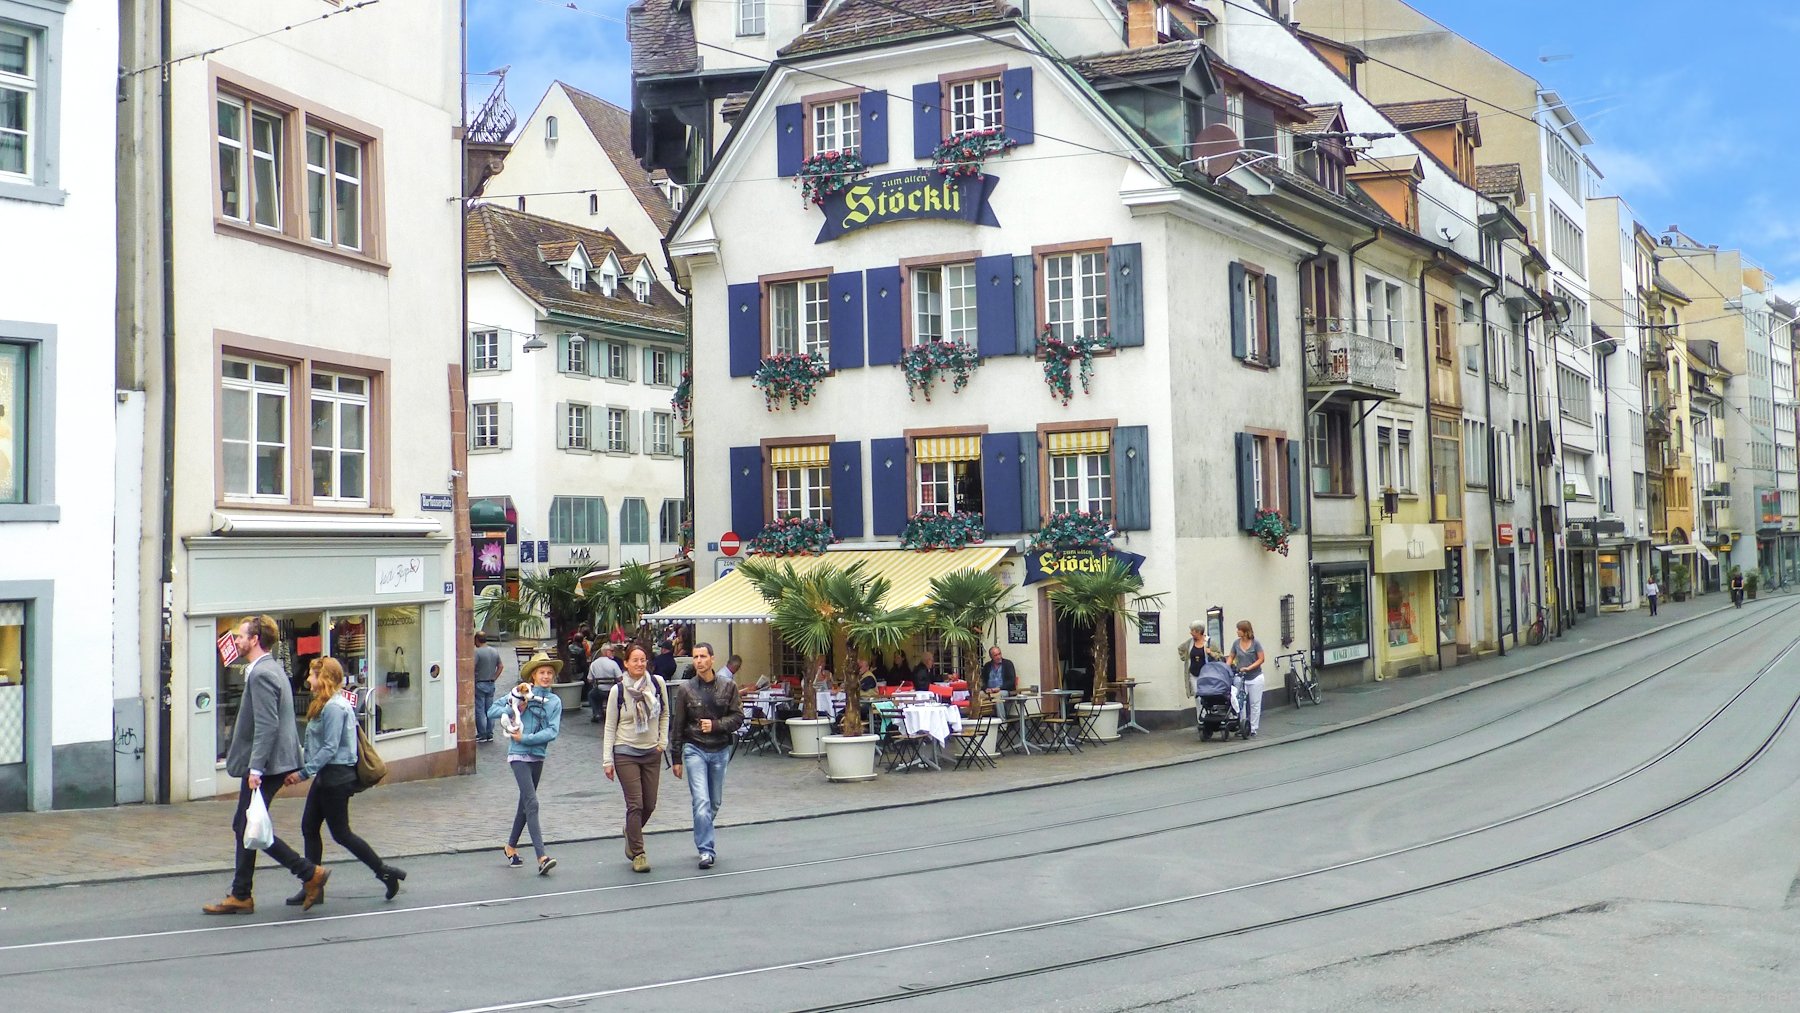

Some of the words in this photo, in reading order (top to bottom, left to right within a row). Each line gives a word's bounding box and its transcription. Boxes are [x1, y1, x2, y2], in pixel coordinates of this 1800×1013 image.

[882, 178, 903, 188] zum
[842, 182, 961, 229] Stöckli
[570, 546, 591, 559] MAX
[446, 583, 453, 592] 23
